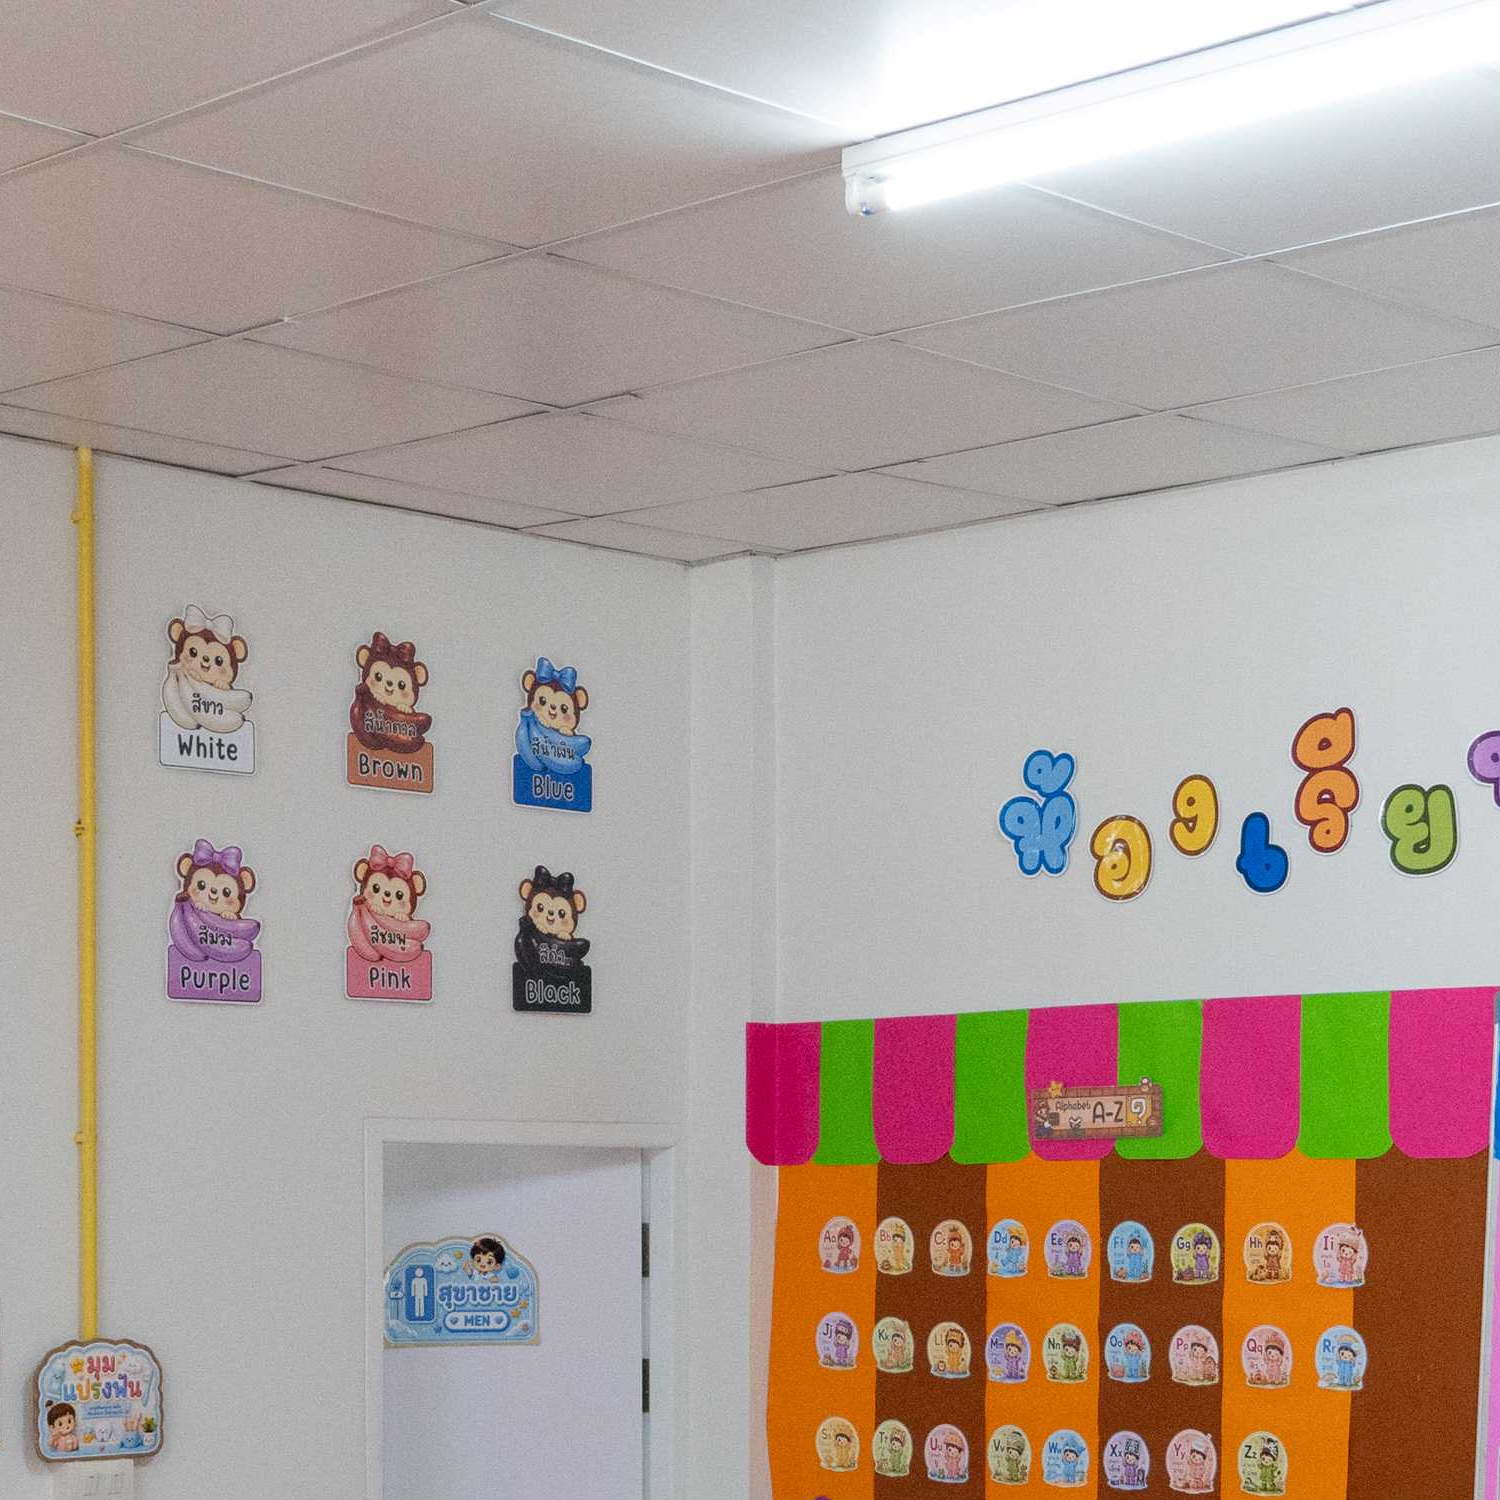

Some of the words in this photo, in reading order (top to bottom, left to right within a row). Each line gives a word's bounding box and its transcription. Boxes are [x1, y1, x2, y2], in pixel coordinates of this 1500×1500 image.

[191, 694, 224, 715] สีขาว
[177, 733, 239, 761] White
[359, 753, 422, 782] Brown
[533, 775, 574, 800] Blue
[199, 924, 233, 947] สีม่วง
[370, 925, 408, 951] สีชมพู
[180, 964, 251, 994] Purple
[368, 965, 411, 989] Pink
[525, 979, 581, 1004] Black
[1092, 1099, 1124, 1124] A-Z
[824, 1230, 837, 1243] Aa
[880, 1229, 891, 1242] Bb
[994, 1231, 1008, 1244] Dd
[1051, 1232, 1064, 1246] Ee
[1176, 1236, 1191, 1251] Gg
[1249, 1236, 1263, 1249] Hh
[1323, 1235, 1334, 1251] Ii
[438, 1284, 518, 1310] สุขาชาย
[464, 1315, 490, 1327] MEN
[822, 1323, 832, 1339] Jj
[1048, 1338, 1061, 1350] Nn
[1109, 1337, 1123, 1348] Oo
[1176, 1338, 1189, 1351] Pp
[1247, 1338, 1263, 1356] Qq
[1322, 1338, 1336, 1353] Rr
[87, 1355, 116, 1381] มุม
[63, 1373, 142, 1401] แปรงฟัน
[930, 1437, 943, 1450] Uu
[993, 1439, 1005, 1453] Vv
[1109, 1444, 1123, 1457] Xx
[1173, 1443, 1186, 1460] Yy
[1244, 1445, 1257, 1459] Zz
